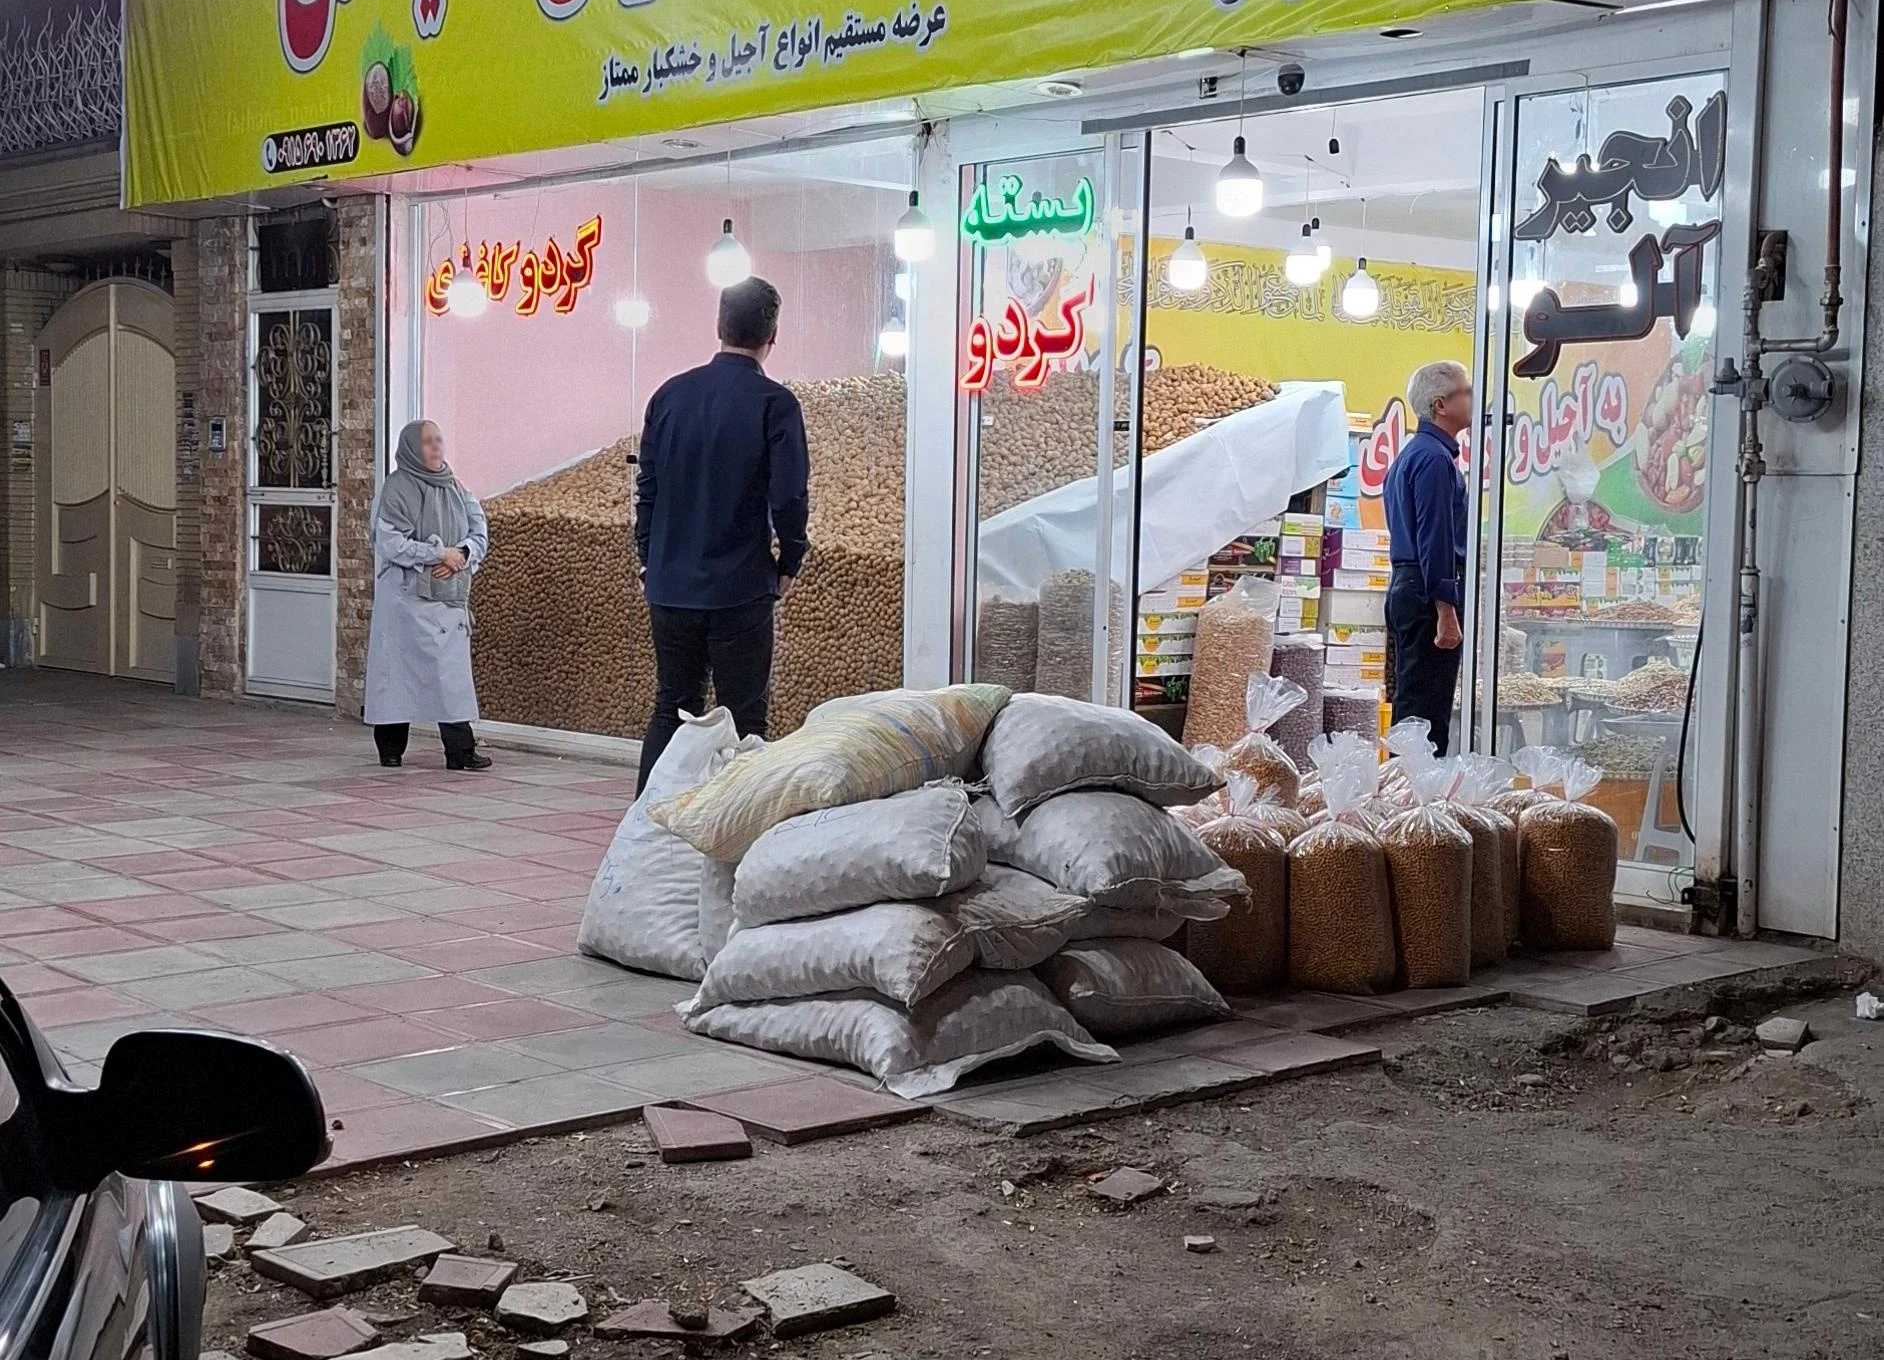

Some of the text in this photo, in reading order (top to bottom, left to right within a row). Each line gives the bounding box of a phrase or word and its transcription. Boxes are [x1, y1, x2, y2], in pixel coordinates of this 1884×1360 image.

[599, 0, 947, 100] عرضه مستقیم انواع آجیل و خشکبار ممتاز
[1513, 90, 1727, 240] انجیر
[515, 212, 602, 317] گردو
[1513, 219, 1722, 378] آلو
[1508, 413, 1533, 483] و
[1597, 374, 1627, 446] به
